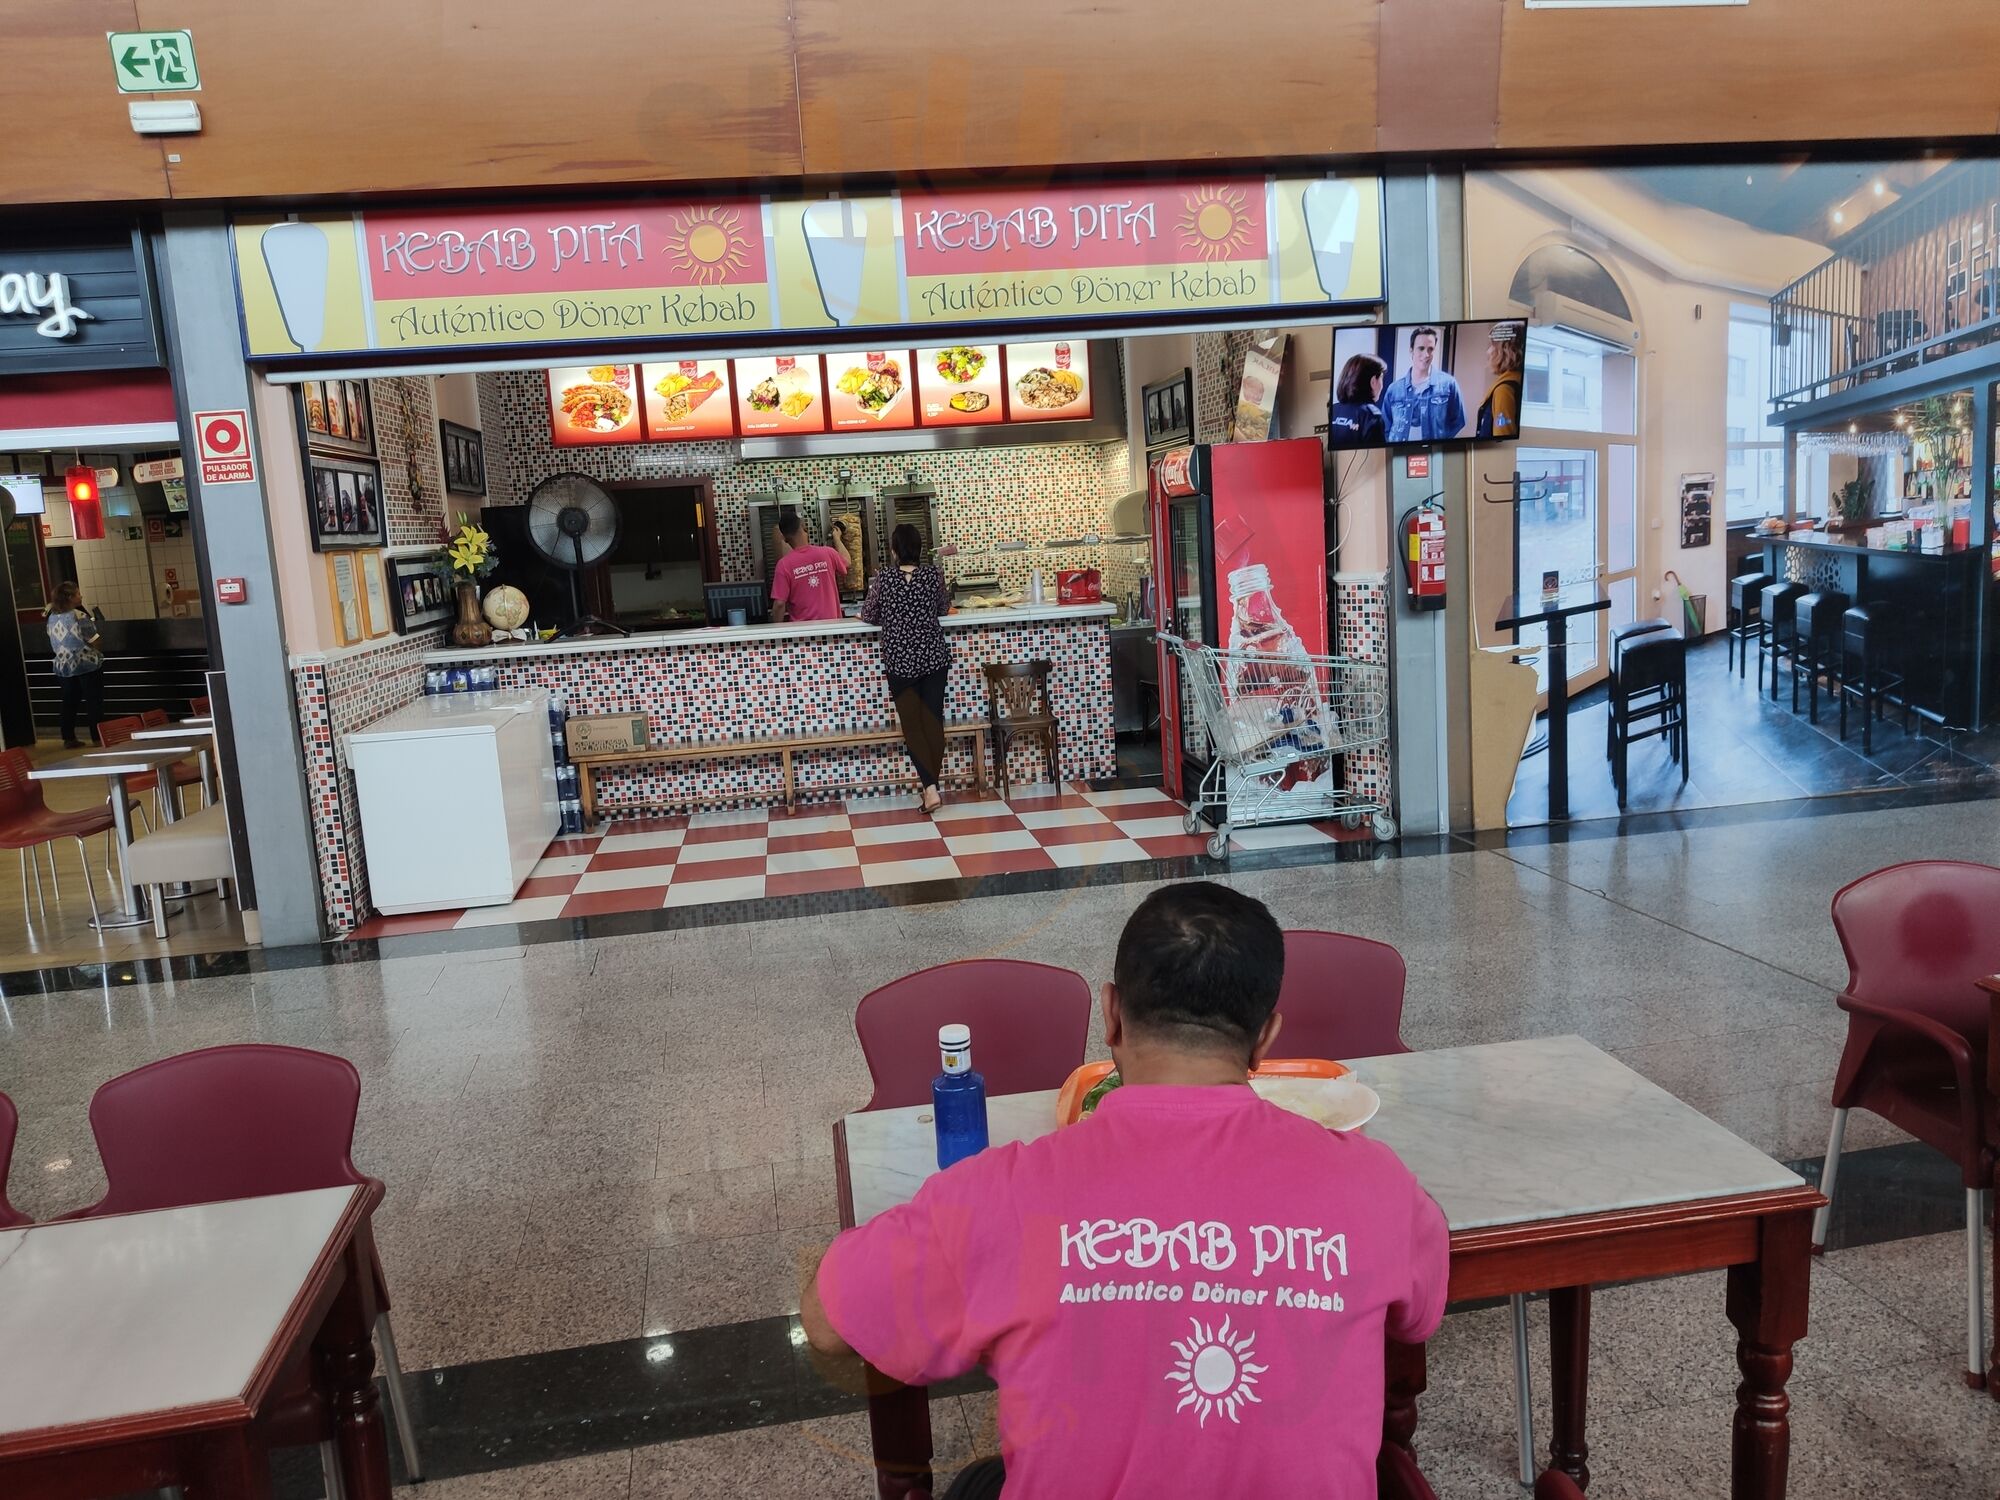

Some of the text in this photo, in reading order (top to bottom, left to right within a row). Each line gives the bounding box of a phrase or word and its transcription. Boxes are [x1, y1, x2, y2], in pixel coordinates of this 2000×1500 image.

[380, 221, 644, 276] KEBAB PITA
[914, 200, 1157, 253] KEBAB PITA
[922, 268, 1256, 316] Auténtico Döner Kebab
[391, 292, 756, 341] Auténtico Döner Kebab
[206, 463, 248, 472] PULSADOR
[206, 472, 251, 482] DE ALARMA
[1060, 1218, 1349, 1281] KEBAB PITA
[1059, 1280, 1345, 1312] Auténtico Döner Kebab
